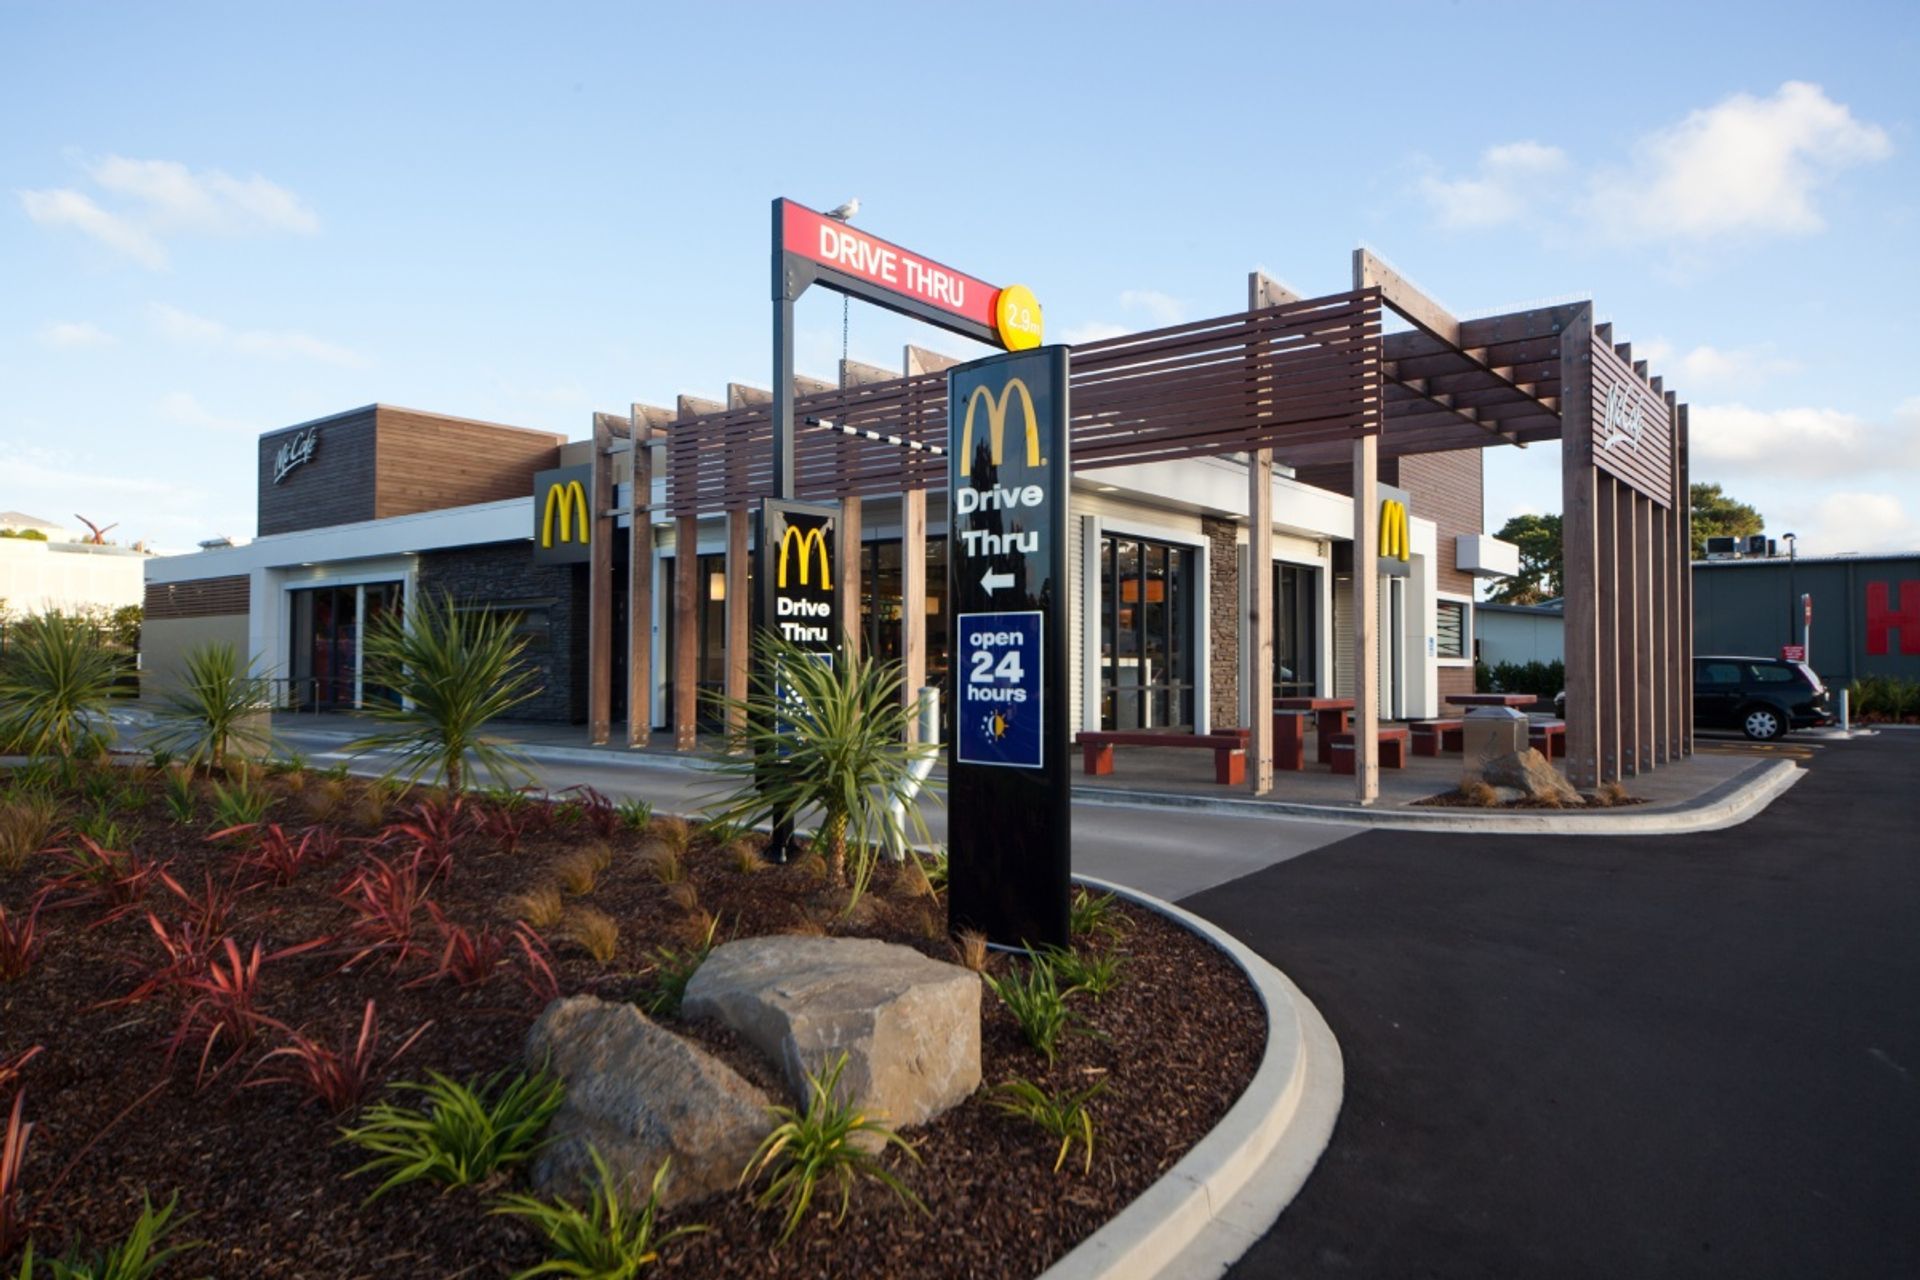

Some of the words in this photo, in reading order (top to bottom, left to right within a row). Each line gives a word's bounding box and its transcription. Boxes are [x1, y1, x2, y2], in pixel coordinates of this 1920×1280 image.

[819, 224, 897, 284] DRIVE
[902, 258, 965, 308] THRU
[956, 484, 1044, 515] Drive
[961, 529, 1039, 557] Thru
[777, 597, 831, 617] Drive
[780, 622, 828, 641] Thru
[969, 631, 1024, 649] open
[969, 650, 1025, 684] 24
[967, 683, 1027, 702] hours
